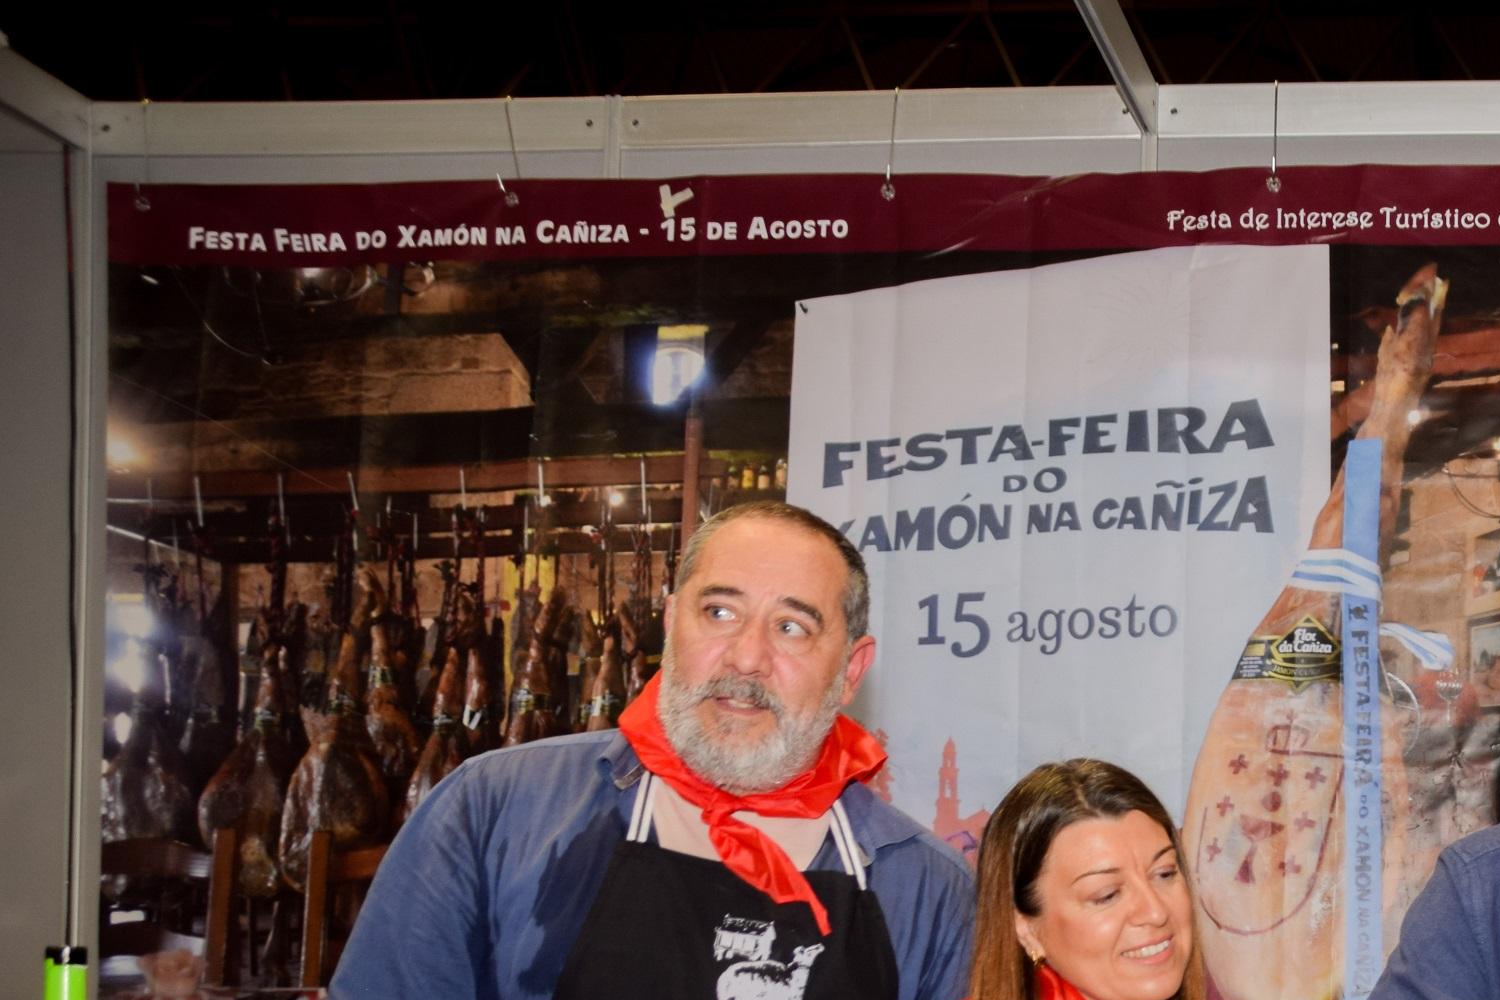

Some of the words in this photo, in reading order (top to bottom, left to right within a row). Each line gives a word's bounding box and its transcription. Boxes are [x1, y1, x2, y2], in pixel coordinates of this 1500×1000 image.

[188, 227, 267, 251] FESTA
[274, 228, 347, 252] FEIRA
[398, 224, 488, 248] XAMÓN
[536, 220, 630, 244] CAÑIZA
[660, 217, 696, 242] 15
[747, 216, 849, 241] AGOSTO
[1167, 208, 1232, 232] Festa
[1239, 207, 1269, 231] de
[1276, 206, 1374, 230] Interese
[1380, 205, 1490, 230] Turístico
[822, 398, 1275, 488] FESTA-FEIRA
[1002, 466, 1068, 494] DO
[1026, 501, 1082, 535] NA
[917, 591, 991, 659] 15
[1006, 592, 1179, 656] agosto
